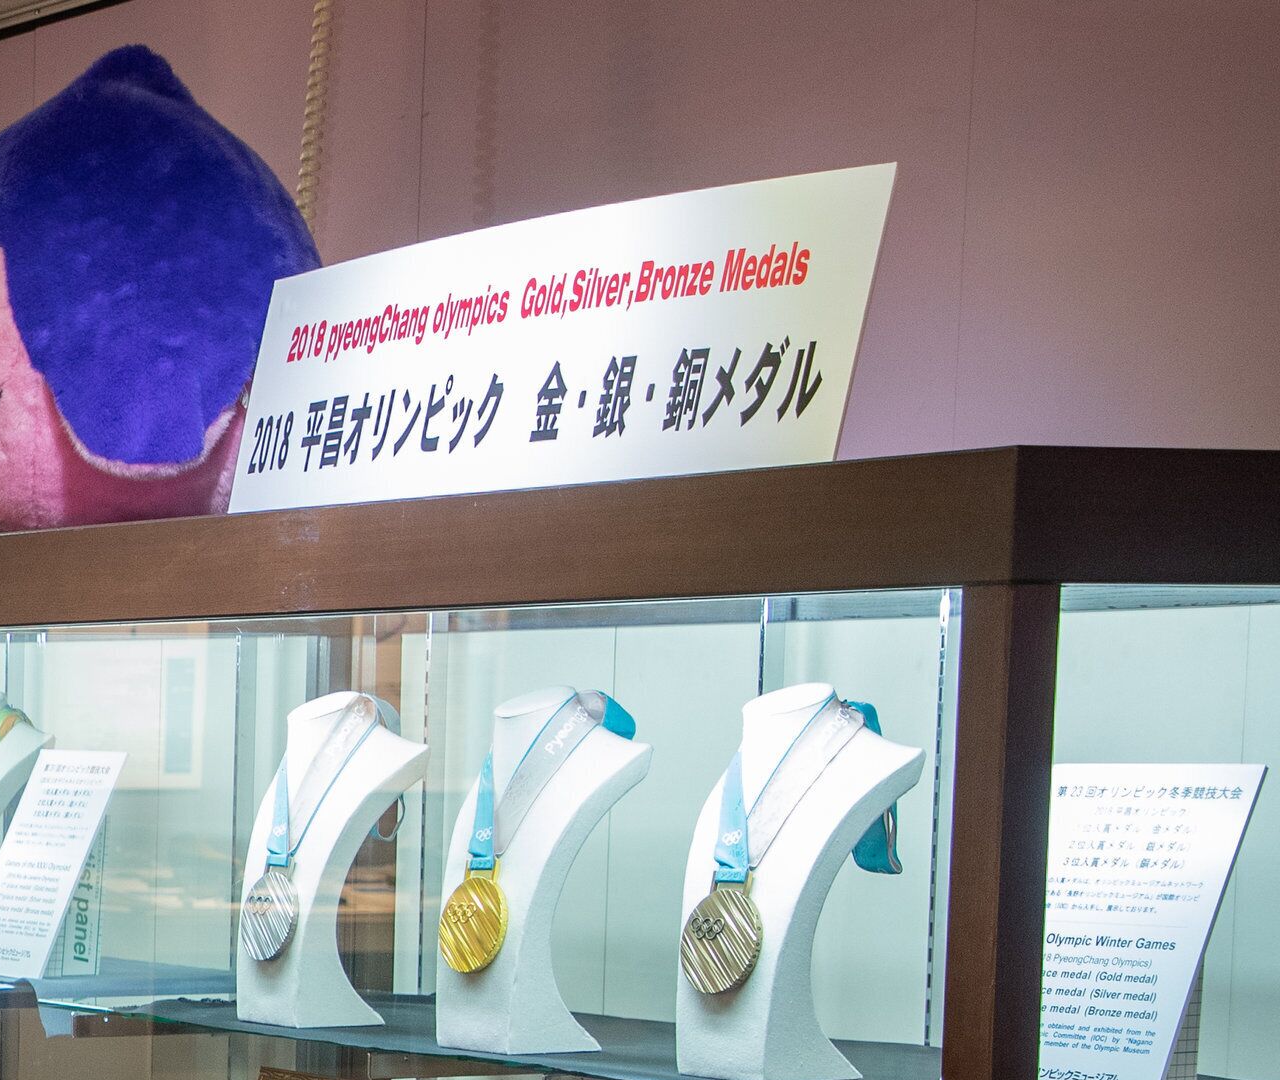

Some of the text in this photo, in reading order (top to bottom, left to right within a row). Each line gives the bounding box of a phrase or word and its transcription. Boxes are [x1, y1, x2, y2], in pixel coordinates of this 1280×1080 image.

[287, 320, 327, 363] 2018
[325, 304, 430, 363] pyeongChang
[433, 285, 510, 340] olympics
[719, 241, 811, 293] Medals
[248, 335, 823, 474] 2018 平昌オリンピック 金・銀・銅メダル
[72, 896, 90, 963] panel
[1046, 932, 1177, 951] Olympic Winter Games
[1053, 953, 1153, 969] PyeongChang Olympics)
[1060, 969, 1158, 986] medal (Gold medal)
[1055, 987, 1157, 1005] medal (Silver medal)
[1049, 1004, 1158, 1022] medal (Bronze medal)
[1047, 1023, 1075, 1031] obtained
[1093, 1026, 1123, 1035] exhibited
[1126, 1028, 1142, 1036] from
[1145, 1029, 1156, 1037] the
[1052, 1031, 1087, 1041] Committee
[1112, 1036, 1120, 1045] by
[1044, 1041, 1150, 1055] member of the Olympic Museum
